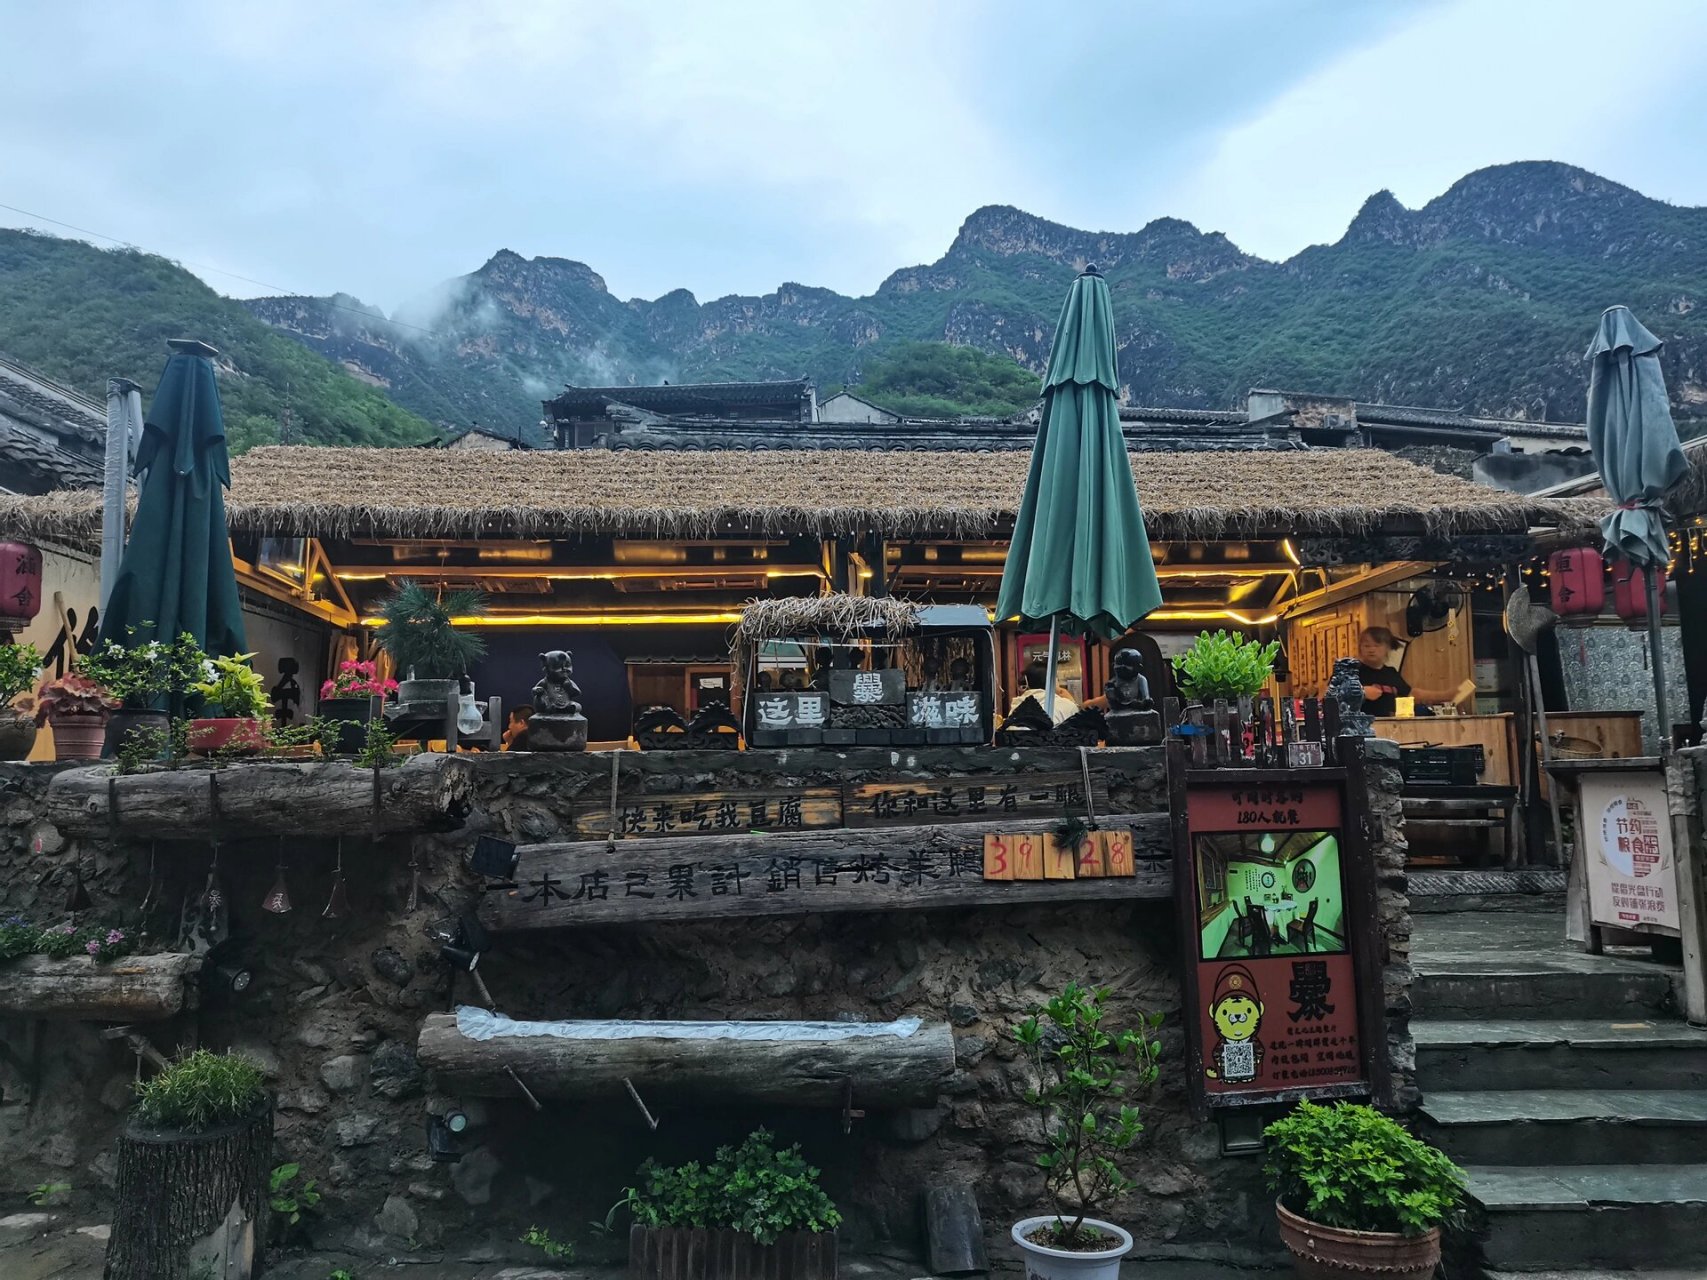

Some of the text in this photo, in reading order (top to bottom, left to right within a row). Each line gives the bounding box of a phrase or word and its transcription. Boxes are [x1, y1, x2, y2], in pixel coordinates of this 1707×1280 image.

[1032, 650, 1072, 662] 元气林
[758, 696, 825, 725] 这里
[912, 695, 981, 724] 滋味
[1299, 752, 1312, 765] 31
[619, 796, 803, 833] 快来吃我豆腐
[1237, 808, 1301, 825] 180人就餐
[1616, 817, 1642, 835] 节约
